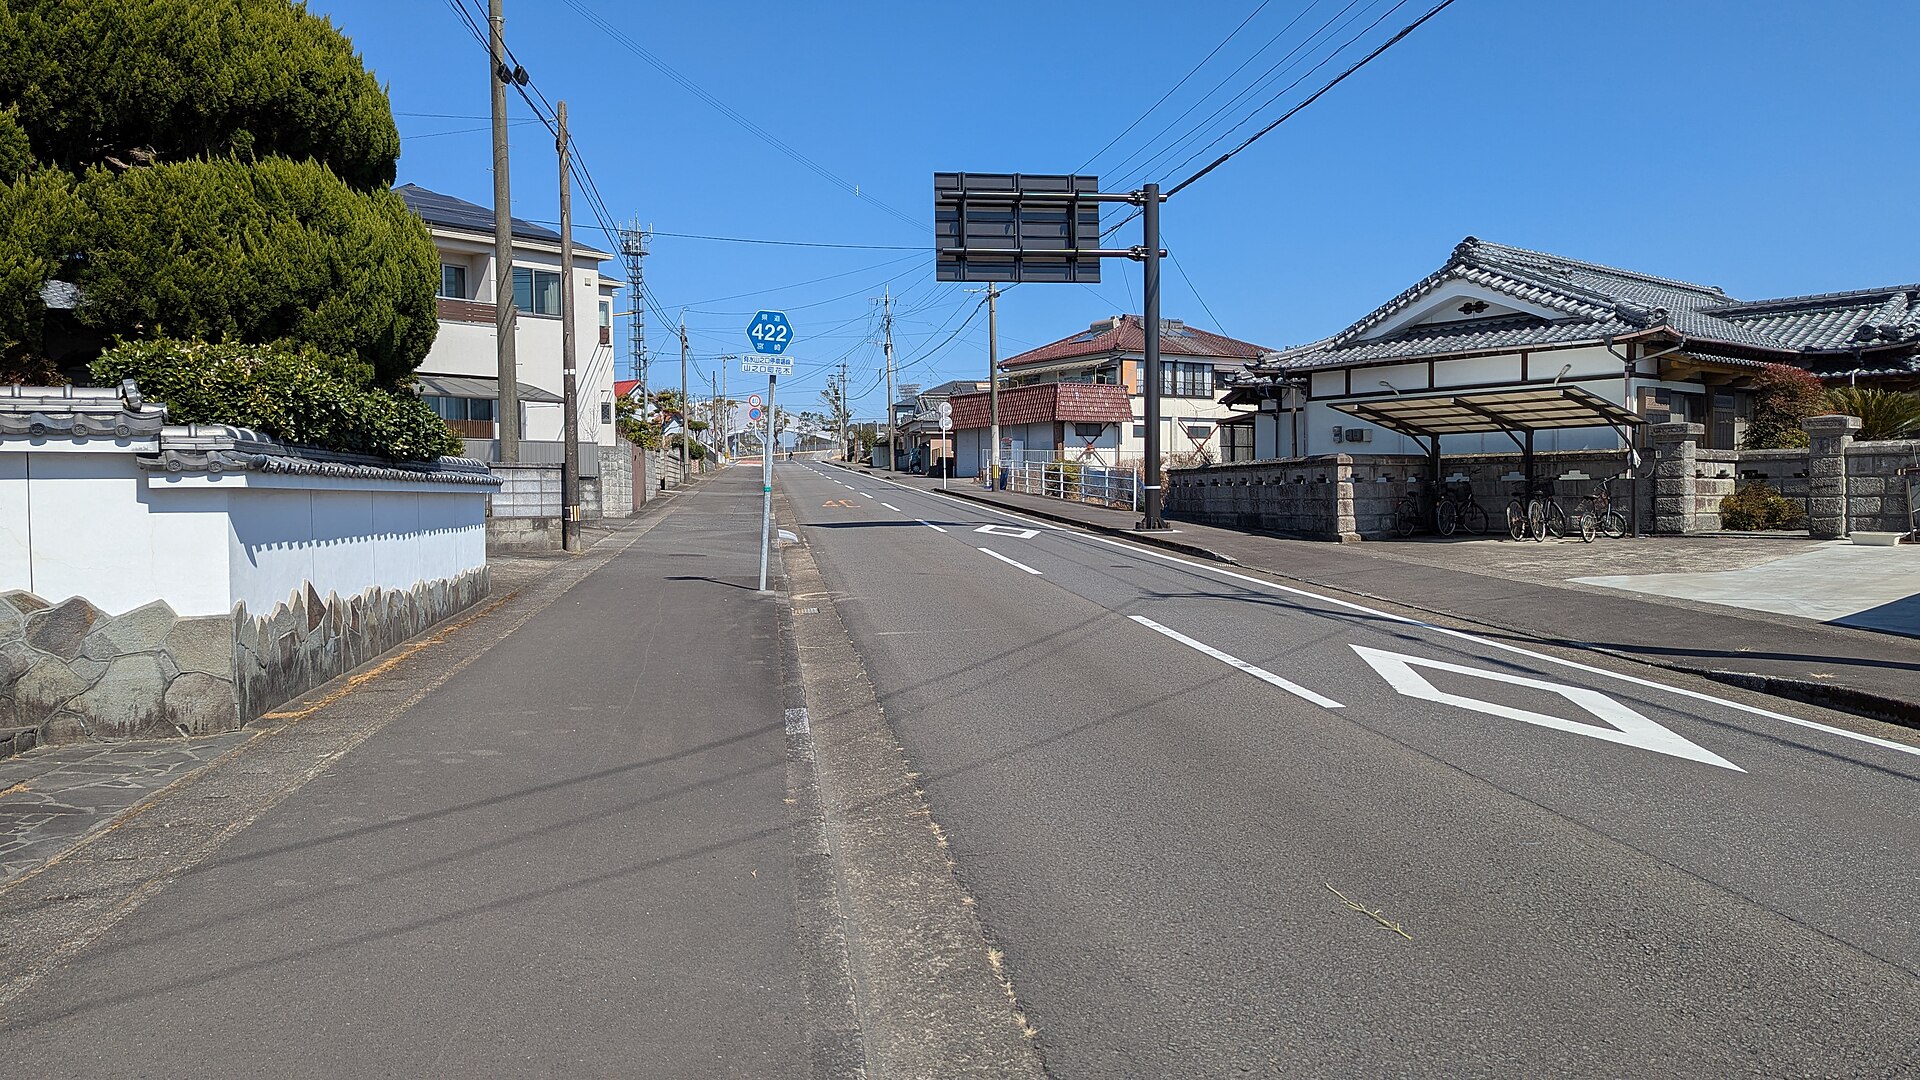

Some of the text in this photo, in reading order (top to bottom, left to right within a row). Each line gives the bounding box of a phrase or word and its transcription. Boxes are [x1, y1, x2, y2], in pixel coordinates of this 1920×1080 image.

[752, 323, 787, 342] 422
[744, 365, 790, 374] 山之口町花木
